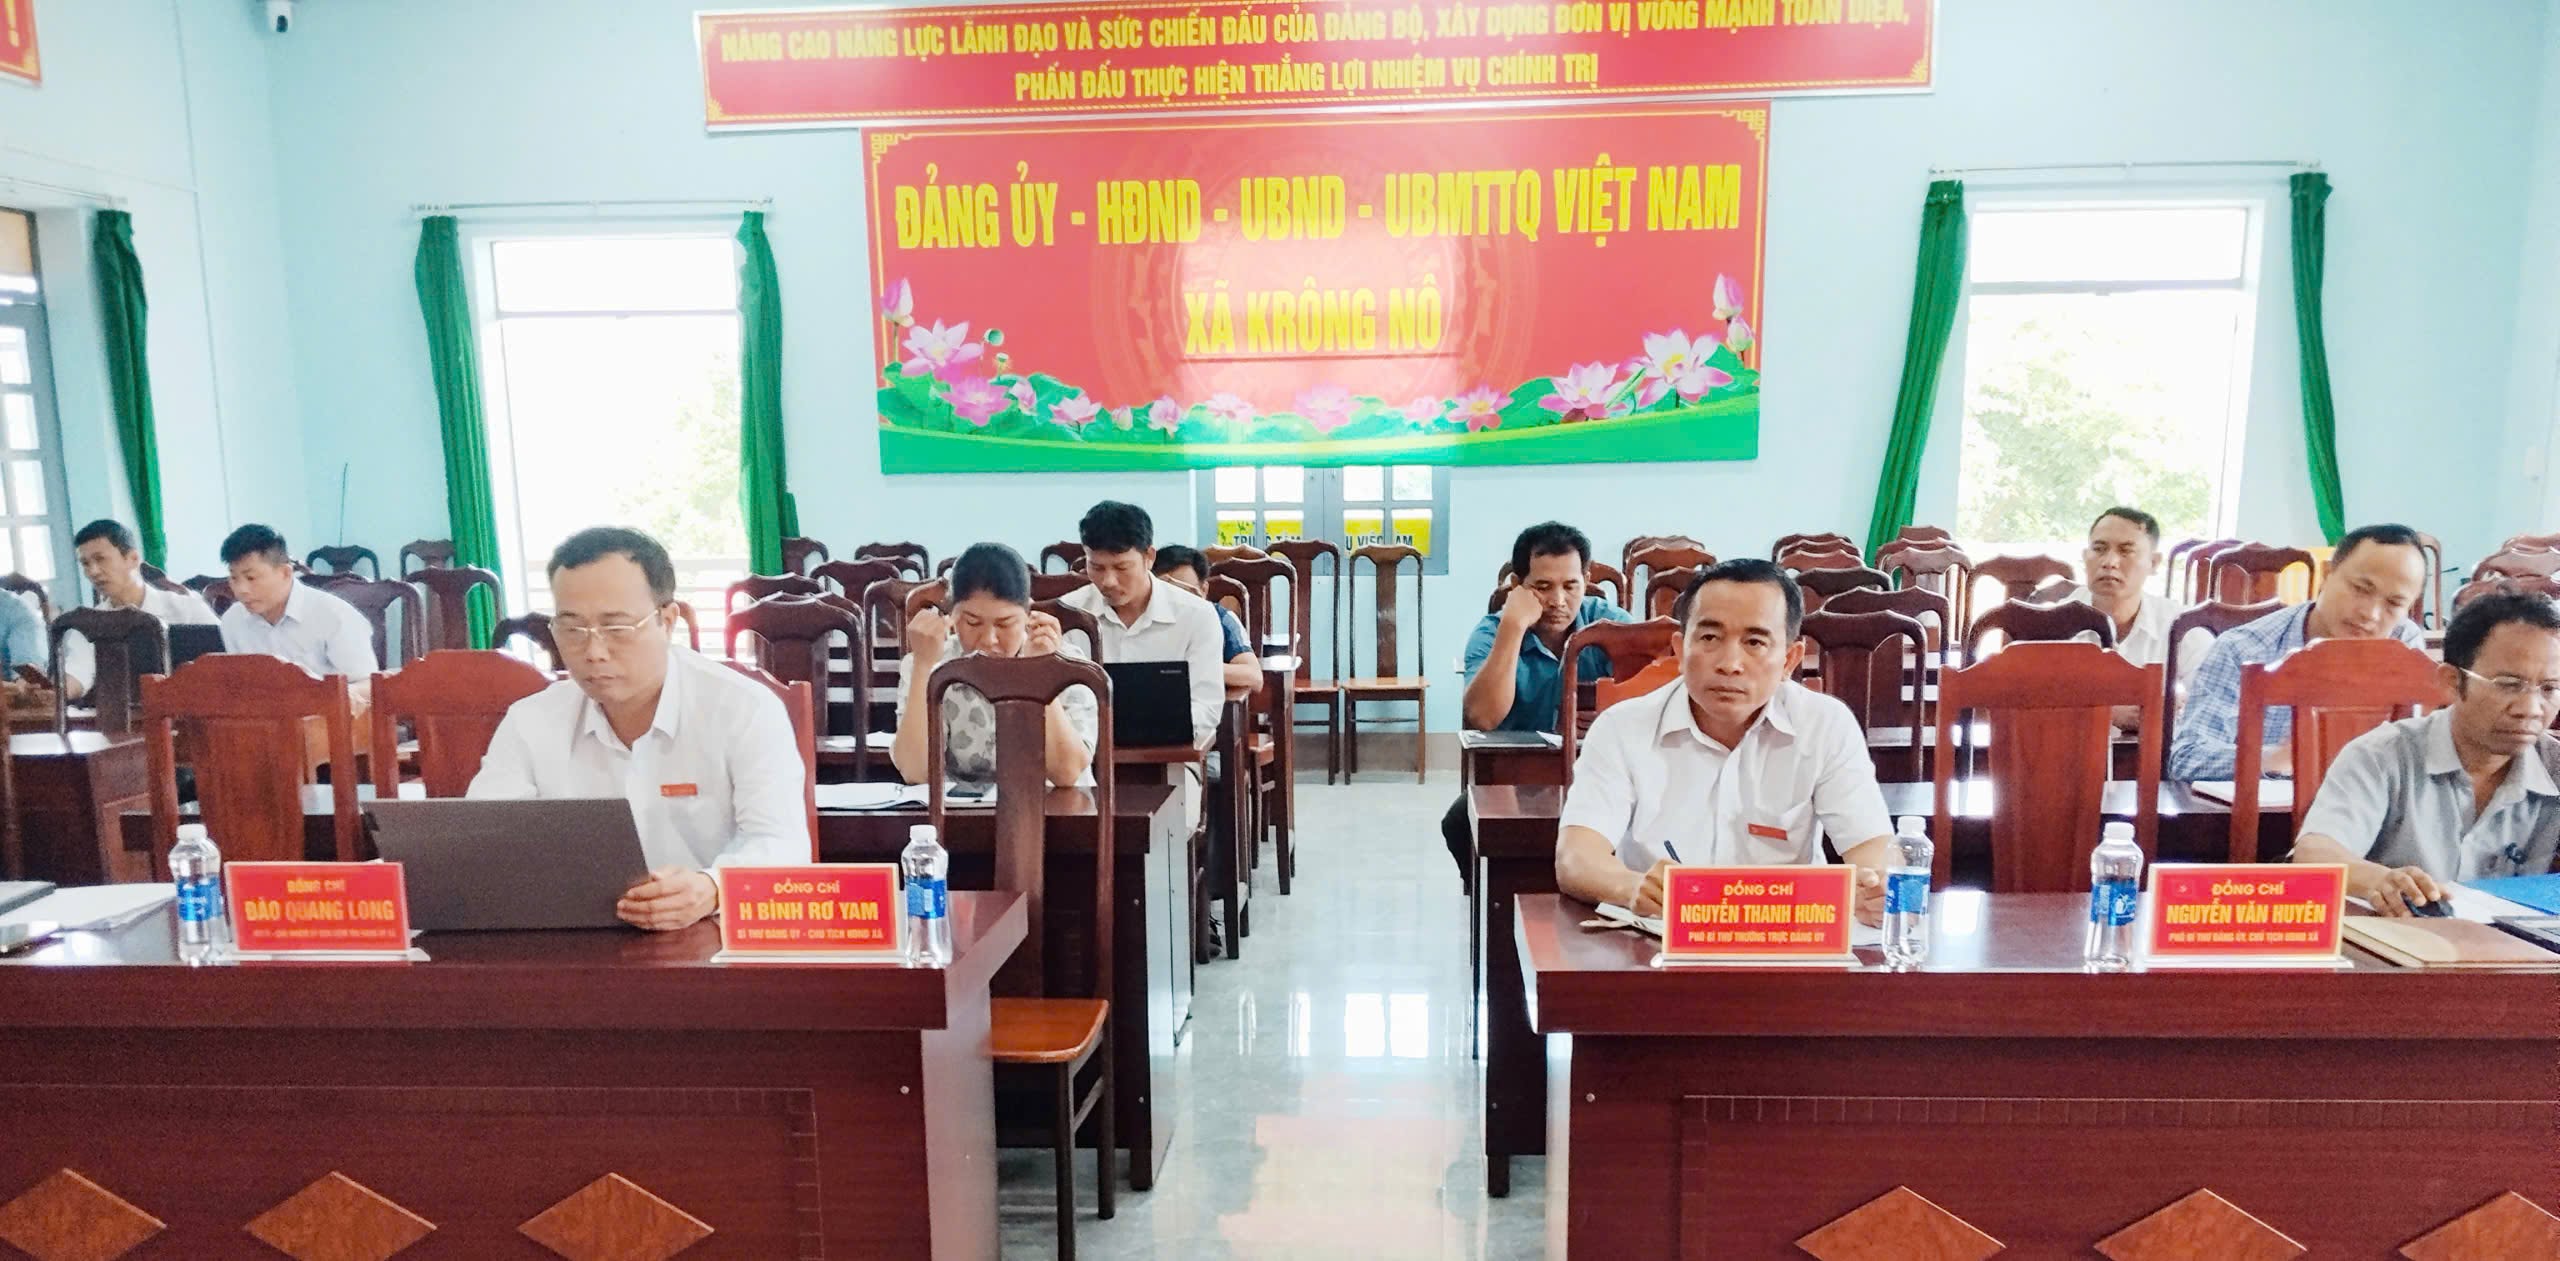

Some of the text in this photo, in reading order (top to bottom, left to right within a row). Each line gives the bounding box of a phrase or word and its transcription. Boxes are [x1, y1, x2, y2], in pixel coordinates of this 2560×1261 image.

[722, 27, 783, 62] NÂNG
[788, 30, 831, 59] CAO
[903, 24, 945, 62] LỰC
[951, 20, 1008, 54] LÃNH
[1014, 23, 1058, 58] ĐẠO
[1064, 16, 1093, 50] VÀ
[1099, 13, 1143, 49] SỨC
[1150, 8, 1216, 47] CHIẾN
[1222, 5, 1267, 44] ĐẤU
[1274, 4, 1319, 44] CỦA
[1324, 3, 1386, 41] ĐẢNG
[1392, 4, 1429, 46] BỘ,
[1436, 3, 1480, 37] XÂY
[1487, 4, 1548, 42] DỰNG
[1555, 1, 1603, 33] ĐƠN
[1609, 2, 1631, 38] VỊ
[1705, 0, 1774, 34] MẠNH
[1015, 49, 1598, 103] PHẤN ĐẤU THỰC HIỆN THẮNG LỢI NHIỆM VỤ CHÍNH TRỊ
[895, 153, 1741, 249] ĐẢNG ỦY - HĐND - UBND - UBMTTQ VIỆT NAM
[1184, 272, 1441, 354] XÃ KRÔNG NÔ
[817, 880, 840, 894] CHÍ
[1768, 881, 1794, 896] CHÍ
[2258, 881, 2285, 895] CHÍ
[245, 896, 395, 923] ĐÀO QUANG LONG
[739, 899, 879, 920] H BÌNH RƠ YAM
[1680, 897, 1739, 924] NGUYỄN
[1743, 904, 1791, 924] THANH
[2166, 897, 2232, 924] NGUYỄN
[2235, 900, 2268, 924] VĂN
